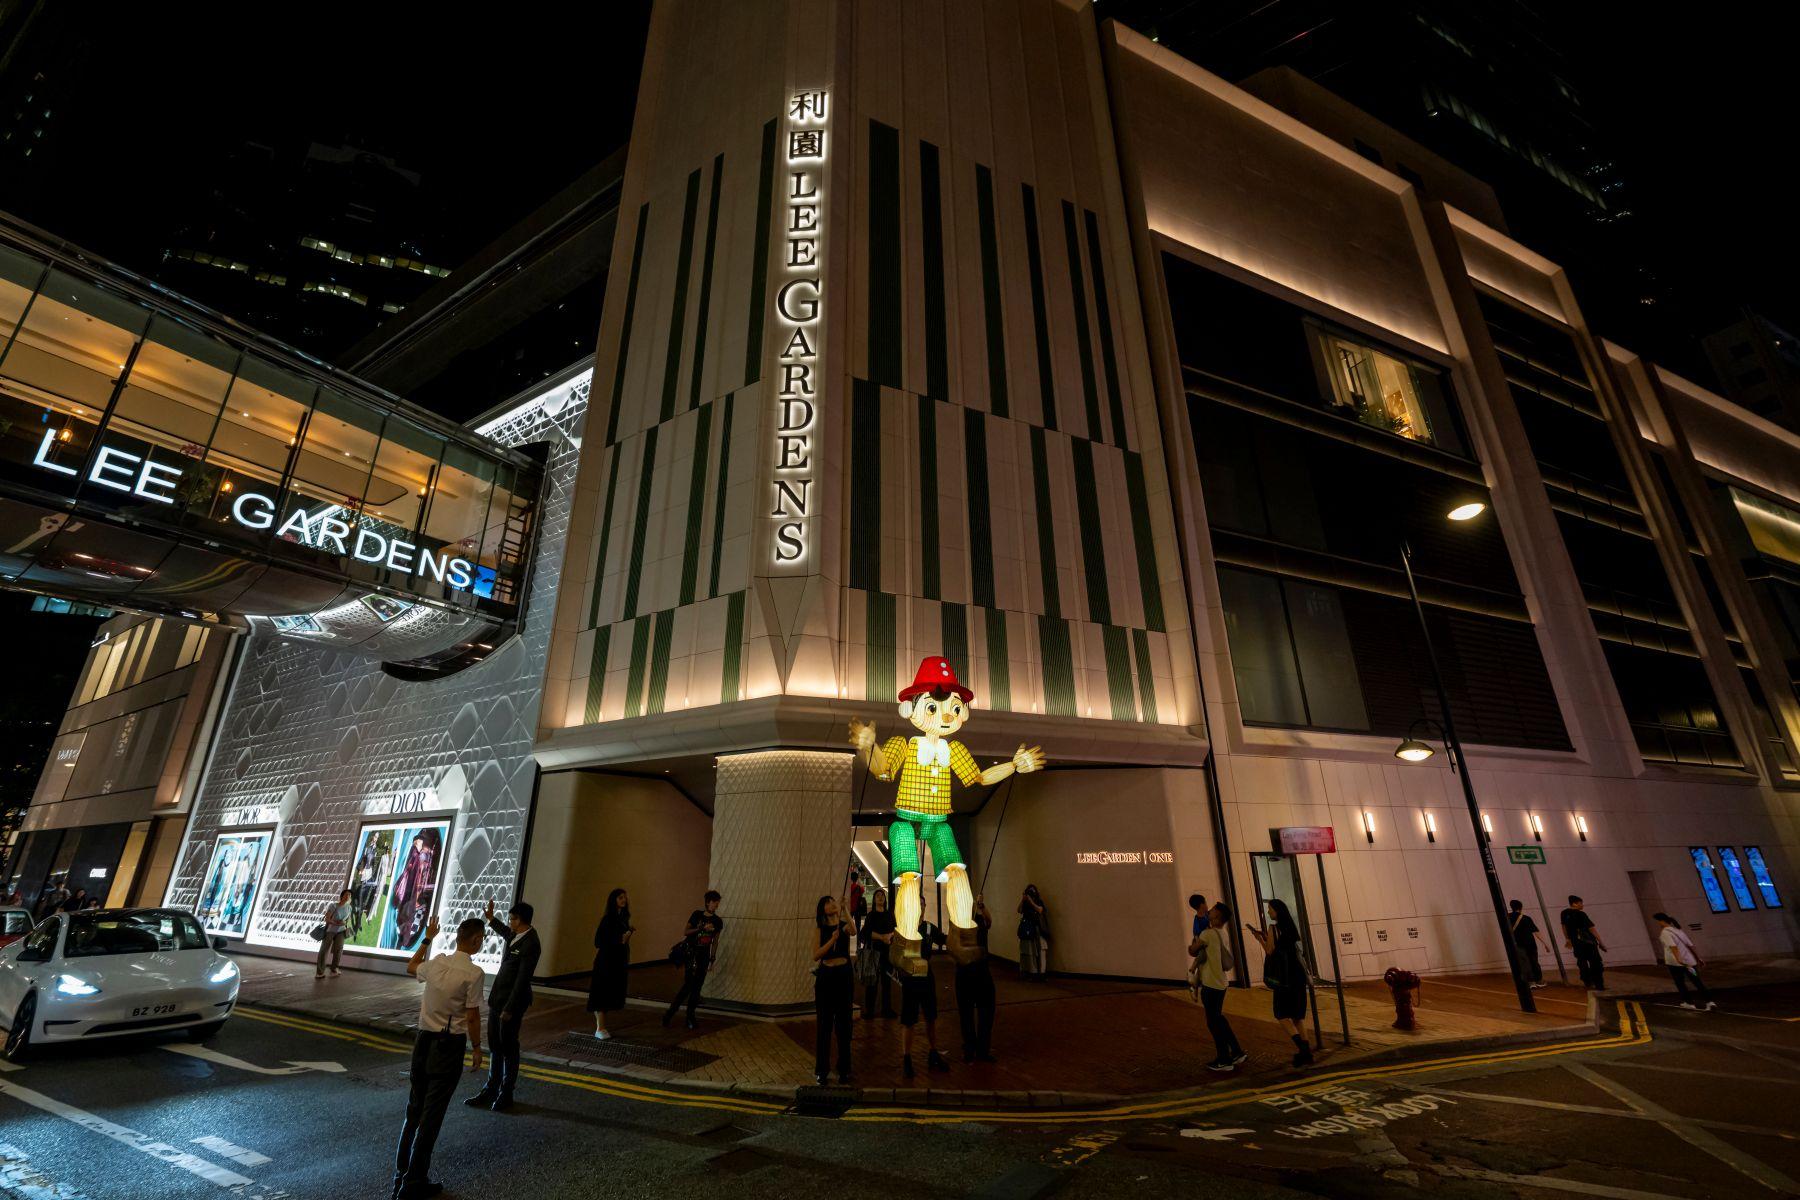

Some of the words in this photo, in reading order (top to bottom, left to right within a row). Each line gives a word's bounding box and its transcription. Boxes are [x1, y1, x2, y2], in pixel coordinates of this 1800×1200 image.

[789, 91, 827, 160] 利園
[787, 172, 817, 266] LEE
[771, 278, 820, 562] GARDENS
[32, 427, 184, 505] LEE
[231, 492, 473, 590] GARDENS
[238, 807, 261, 825] DIOR
[391, 791, 427, 814] DIOR
[1149, 852, 1173, 863] ONE
[132, 1007, 149, 1016] BZ
[153, 1004, 176, 1013] 928
[1360, 1094, 1458, 1121] LOOK
[1273, 1111, 1387, 1139] RIGHT
